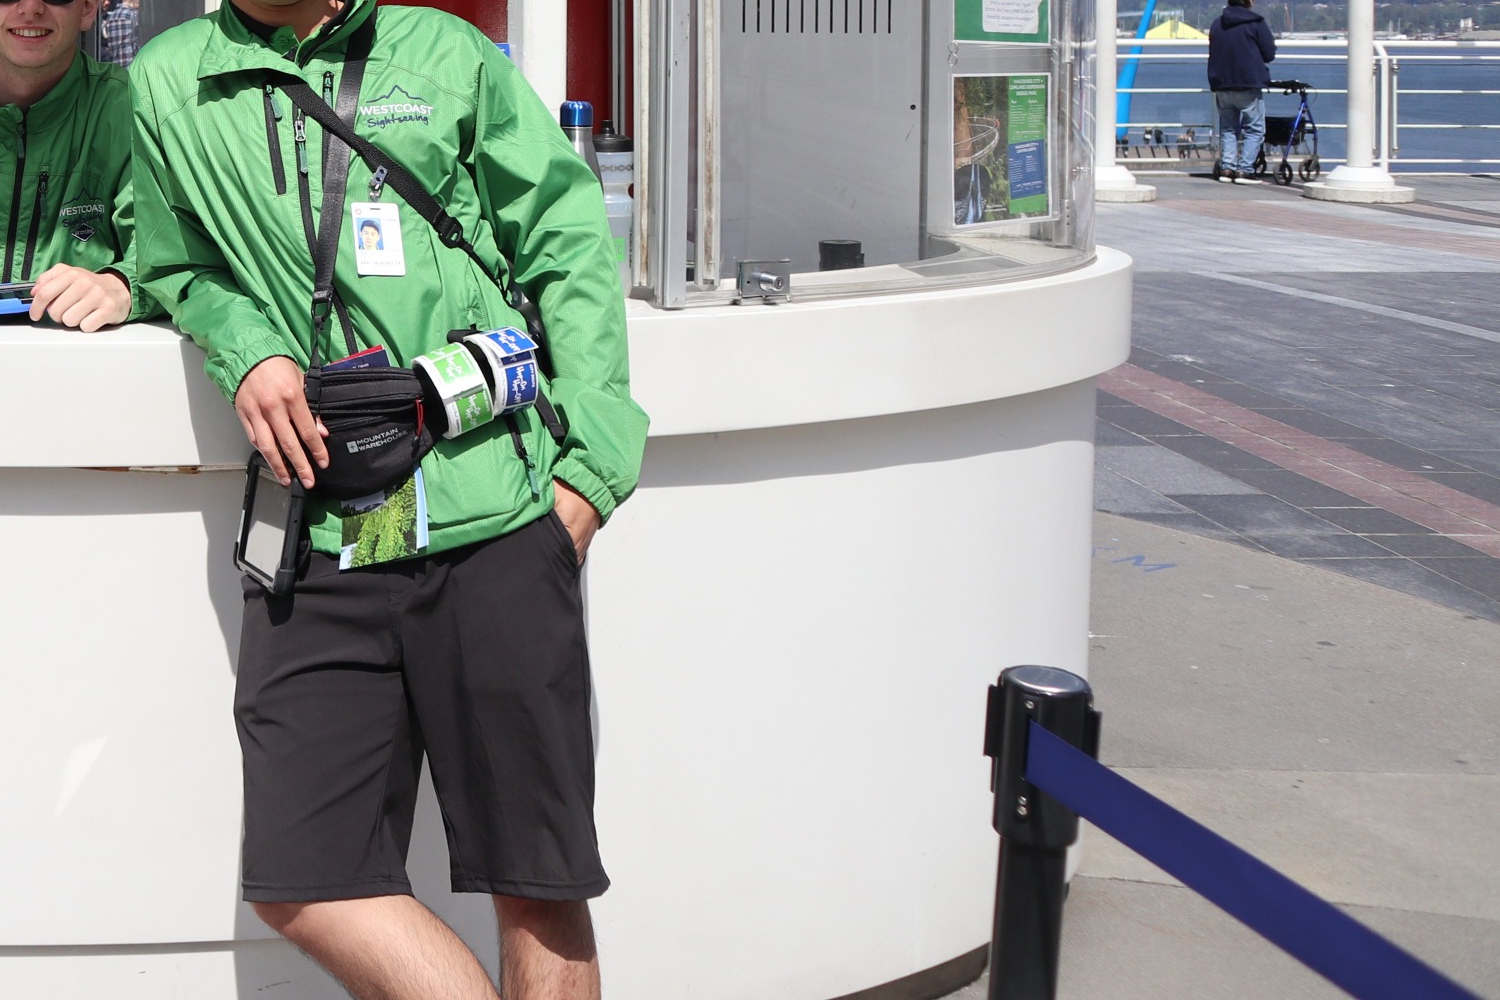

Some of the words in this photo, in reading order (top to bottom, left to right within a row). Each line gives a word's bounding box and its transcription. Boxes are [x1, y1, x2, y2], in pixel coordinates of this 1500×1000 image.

[360, 103, 434, 116] WESTCOAST
[367, 114, 429, 129] Sightseeing
[356, 427, 399, 446] MOUNTAIN
[358, 429, 408, 452] WAREHOUSE
